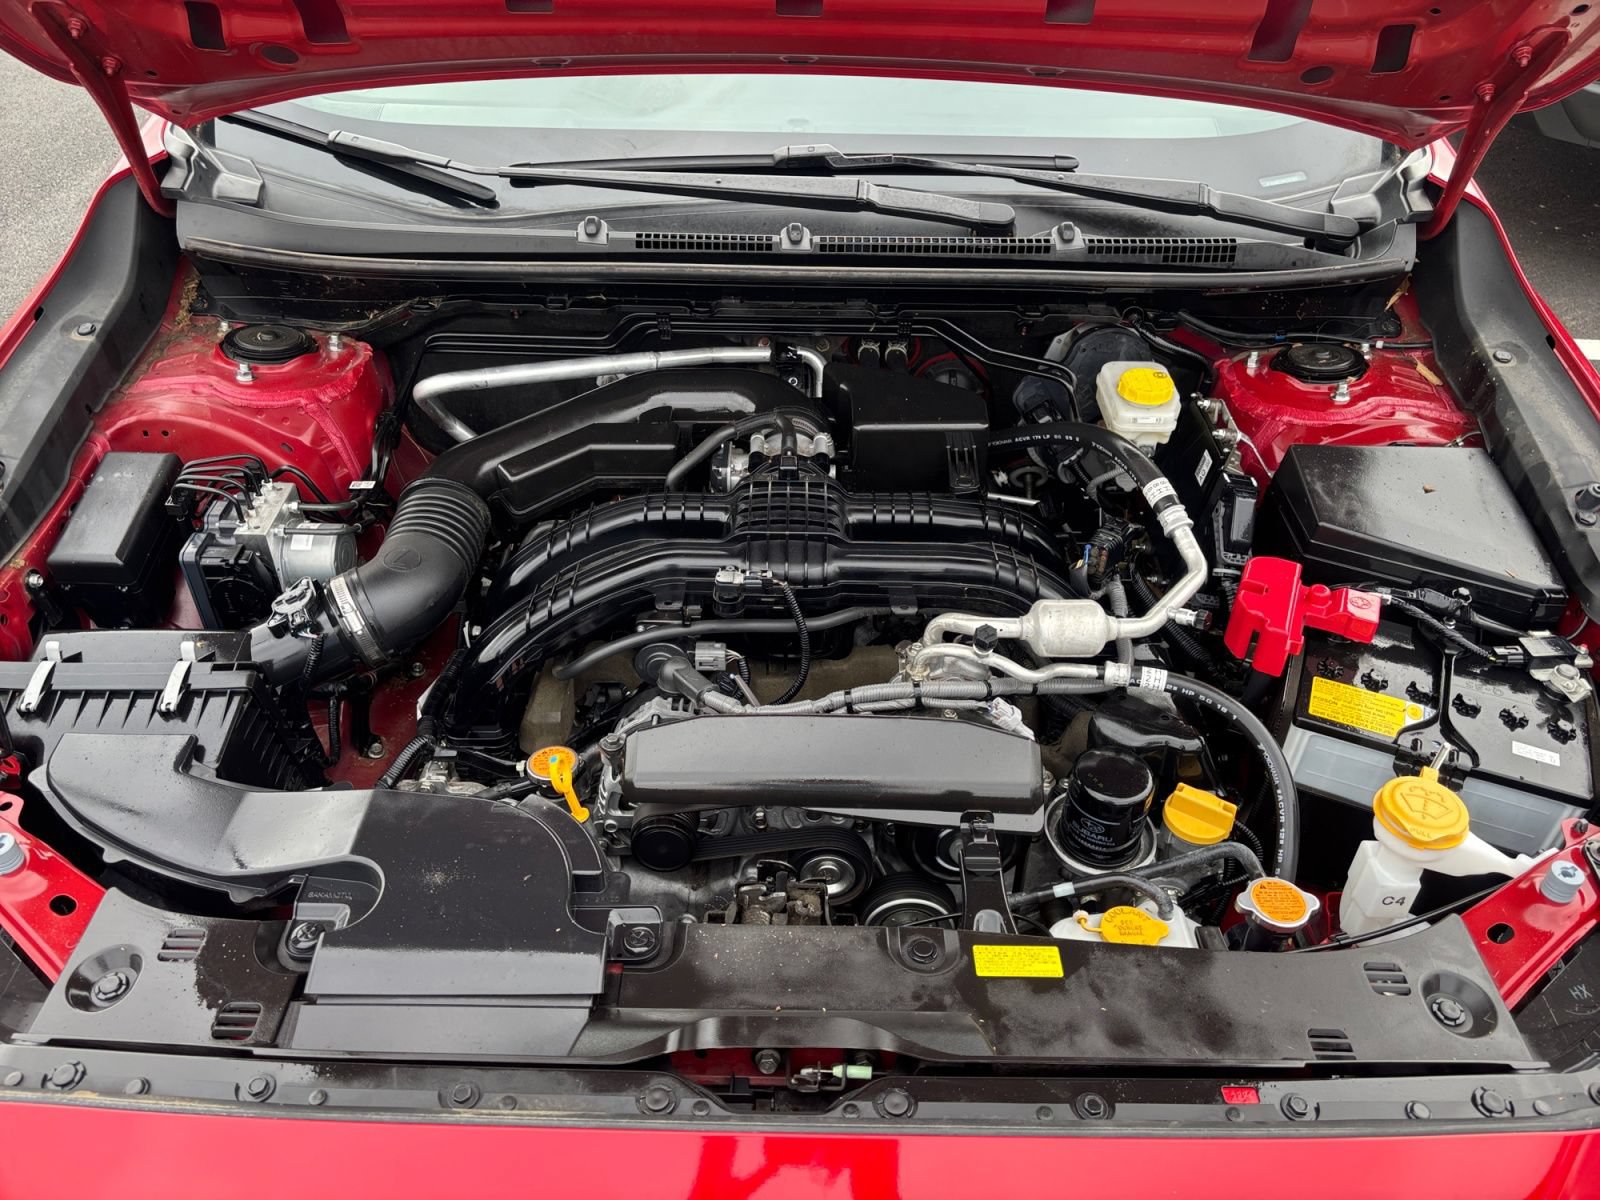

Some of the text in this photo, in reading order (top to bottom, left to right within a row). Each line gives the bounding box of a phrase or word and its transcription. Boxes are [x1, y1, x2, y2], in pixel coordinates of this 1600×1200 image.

[1182, 688, 1195, 696] HP
[1382, 896, 1406, 906] C4
[1104, 907, 1151, 923] COOLANT
